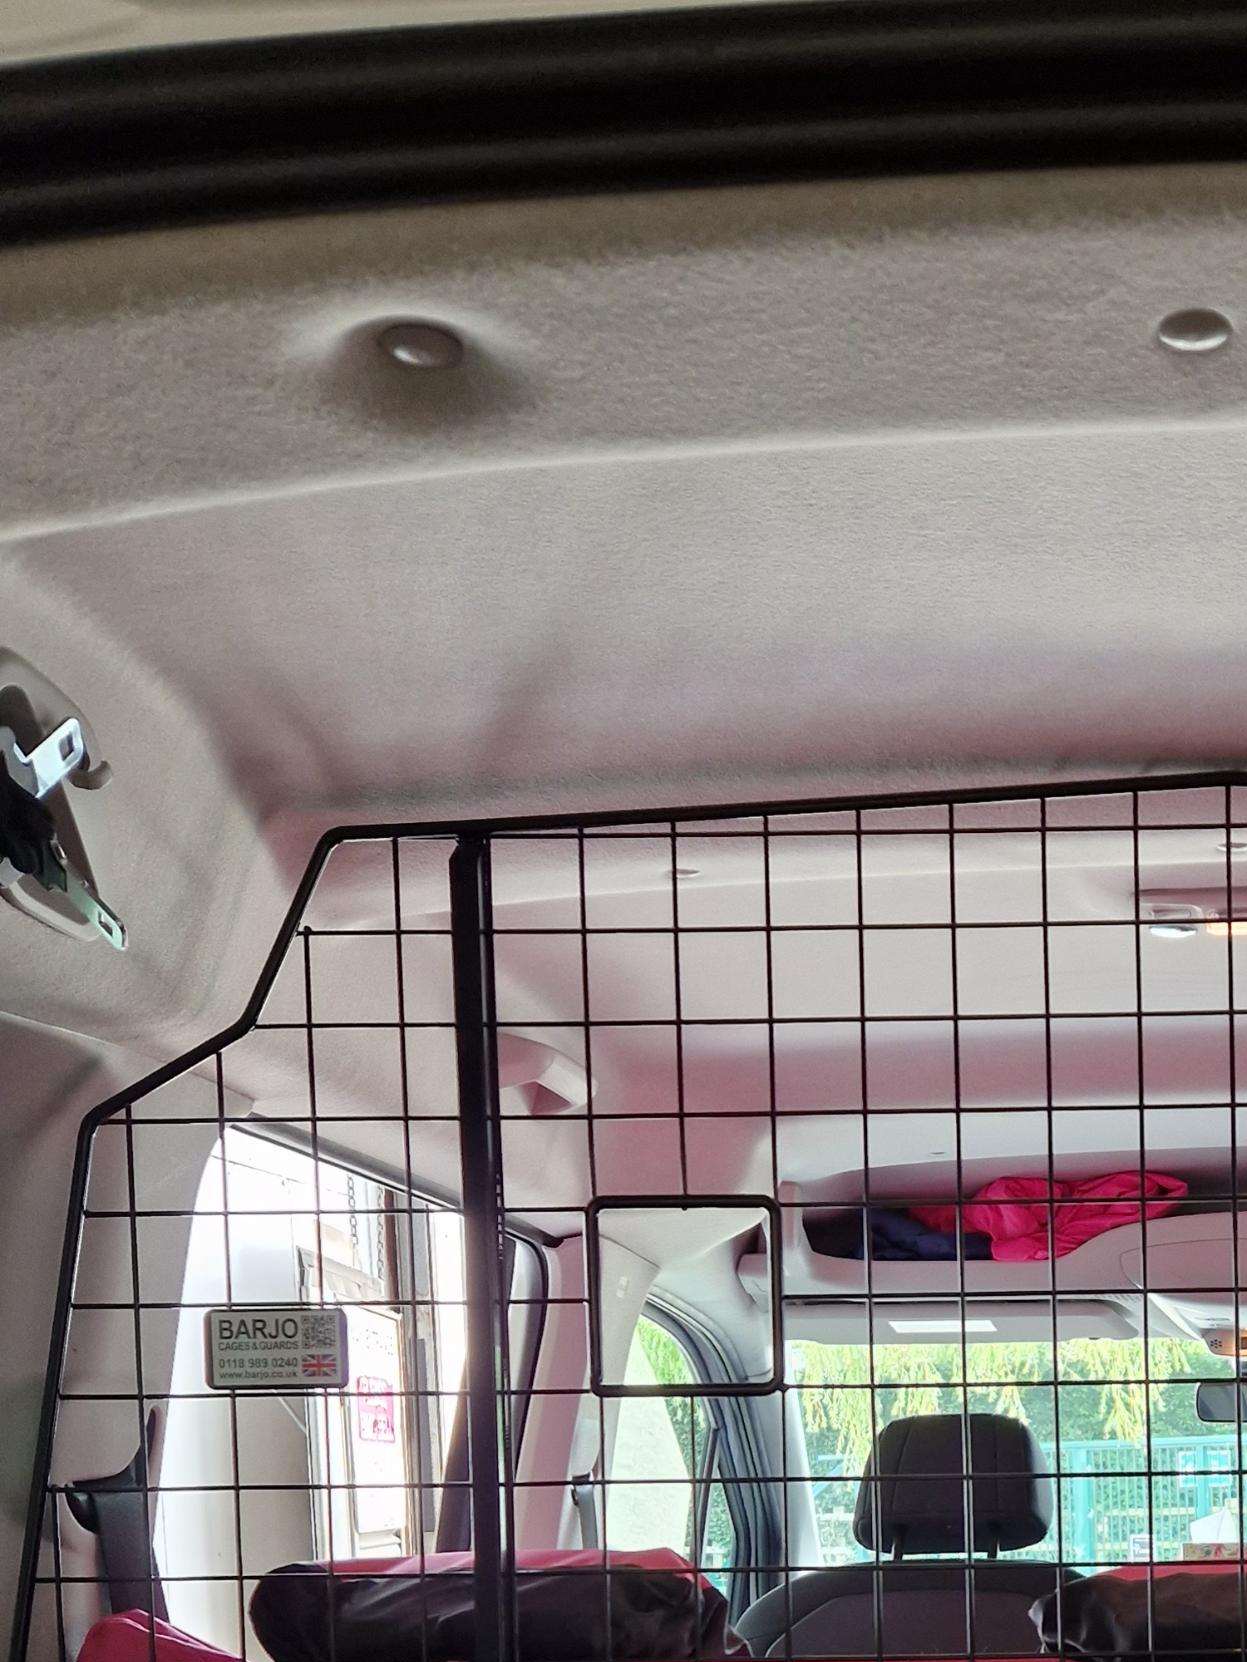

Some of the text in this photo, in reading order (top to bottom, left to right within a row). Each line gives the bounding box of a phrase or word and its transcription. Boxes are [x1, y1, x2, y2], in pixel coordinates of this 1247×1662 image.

[218, 1318, 298, 1339] BARJO
[218, 1340, 299, 1350] CAGES & GUARDS
[218, 1357, 298, 1368] 0118 989 0240
[220, 1370, 298, 1380] www.barjo.co.uk
